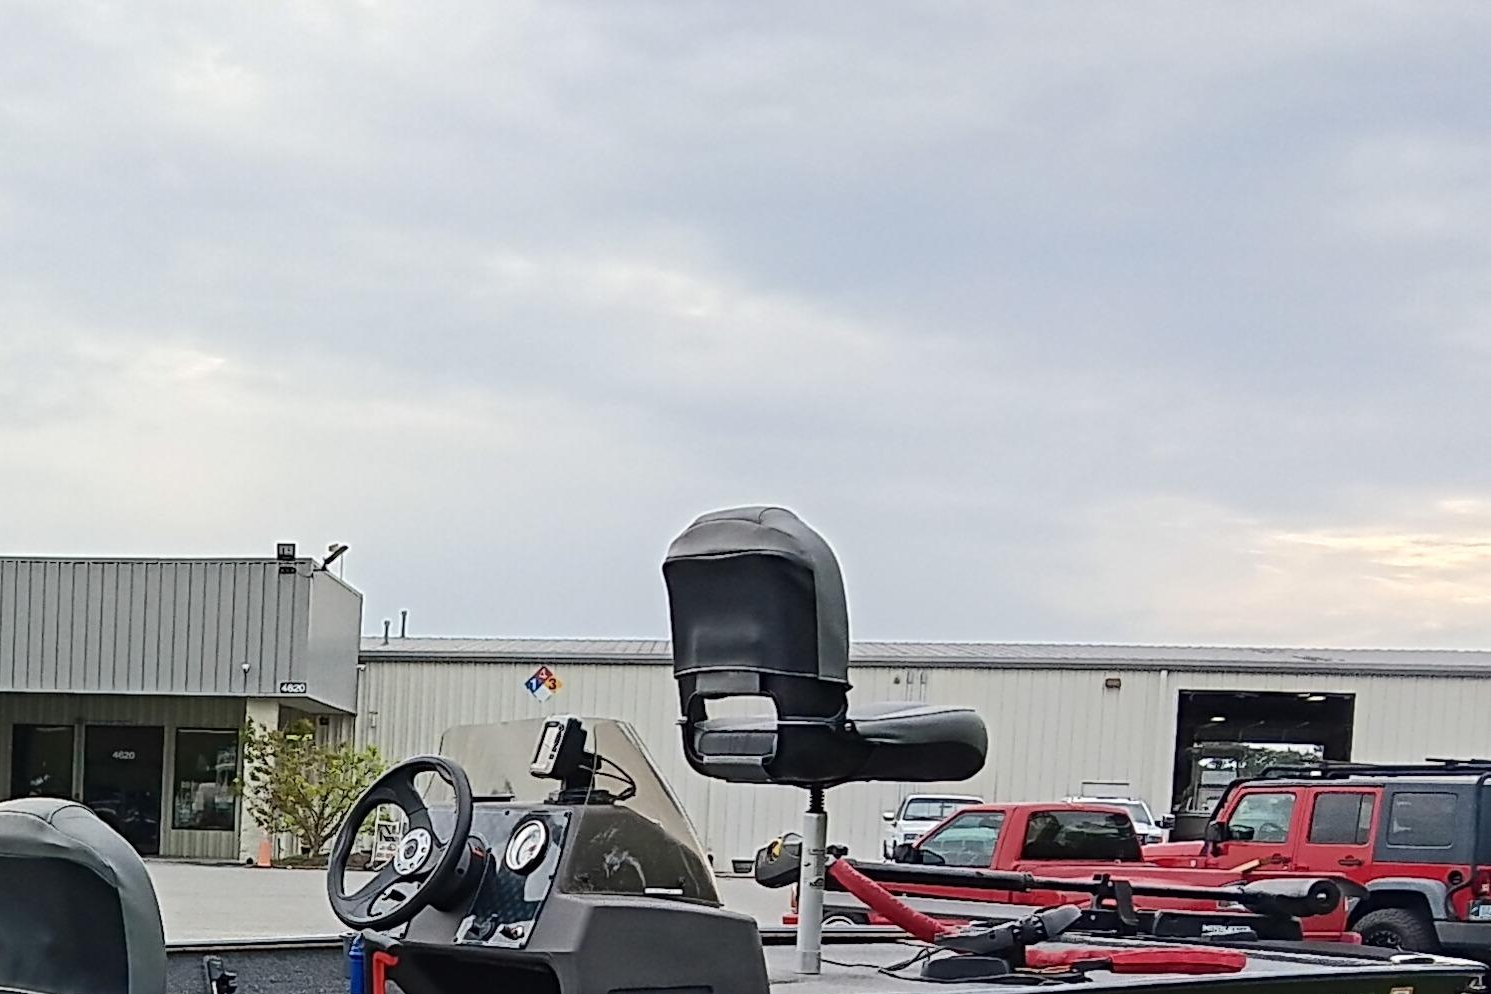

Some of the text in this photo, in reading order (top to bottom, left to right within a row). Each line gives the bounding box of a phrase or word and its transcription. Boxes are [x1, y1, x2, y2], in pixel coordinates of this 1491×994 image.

[280, 683, 307, 694] 4620
[548, 678, 557, 690] 3
[112, 750, 136, 761] 4620
